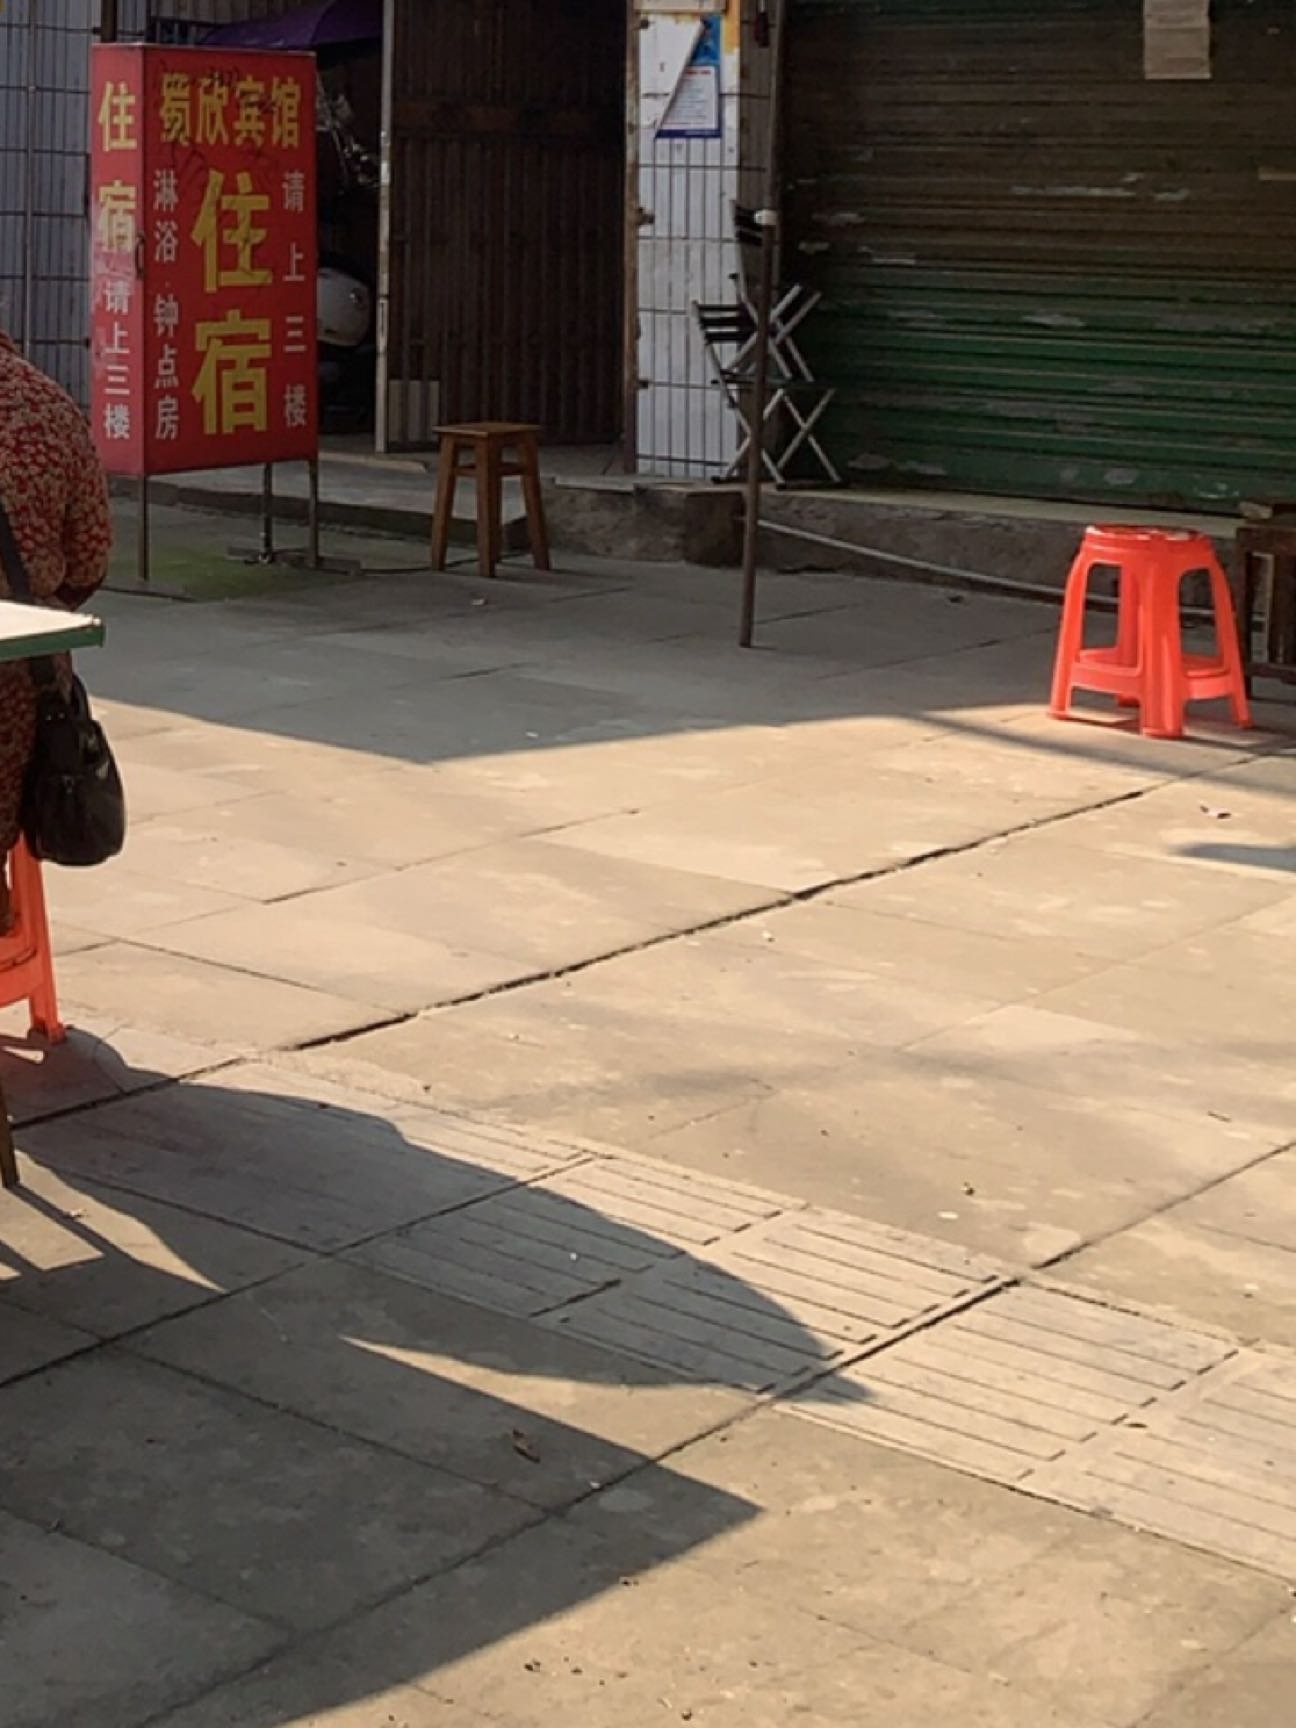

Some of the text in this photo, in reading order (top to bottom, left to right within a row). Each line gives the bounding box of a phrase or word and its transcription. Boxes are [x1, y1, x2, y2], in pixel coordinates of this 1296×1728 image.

[98, 81, 138, 254] 住宿
[159, 75, 302, 148] 蜀欣宾馆
[103, 280, 131, 440] 请上三楼
[191, 168, 273, 436] 住宿
[282, 170, 308, 428] 请上三楼
